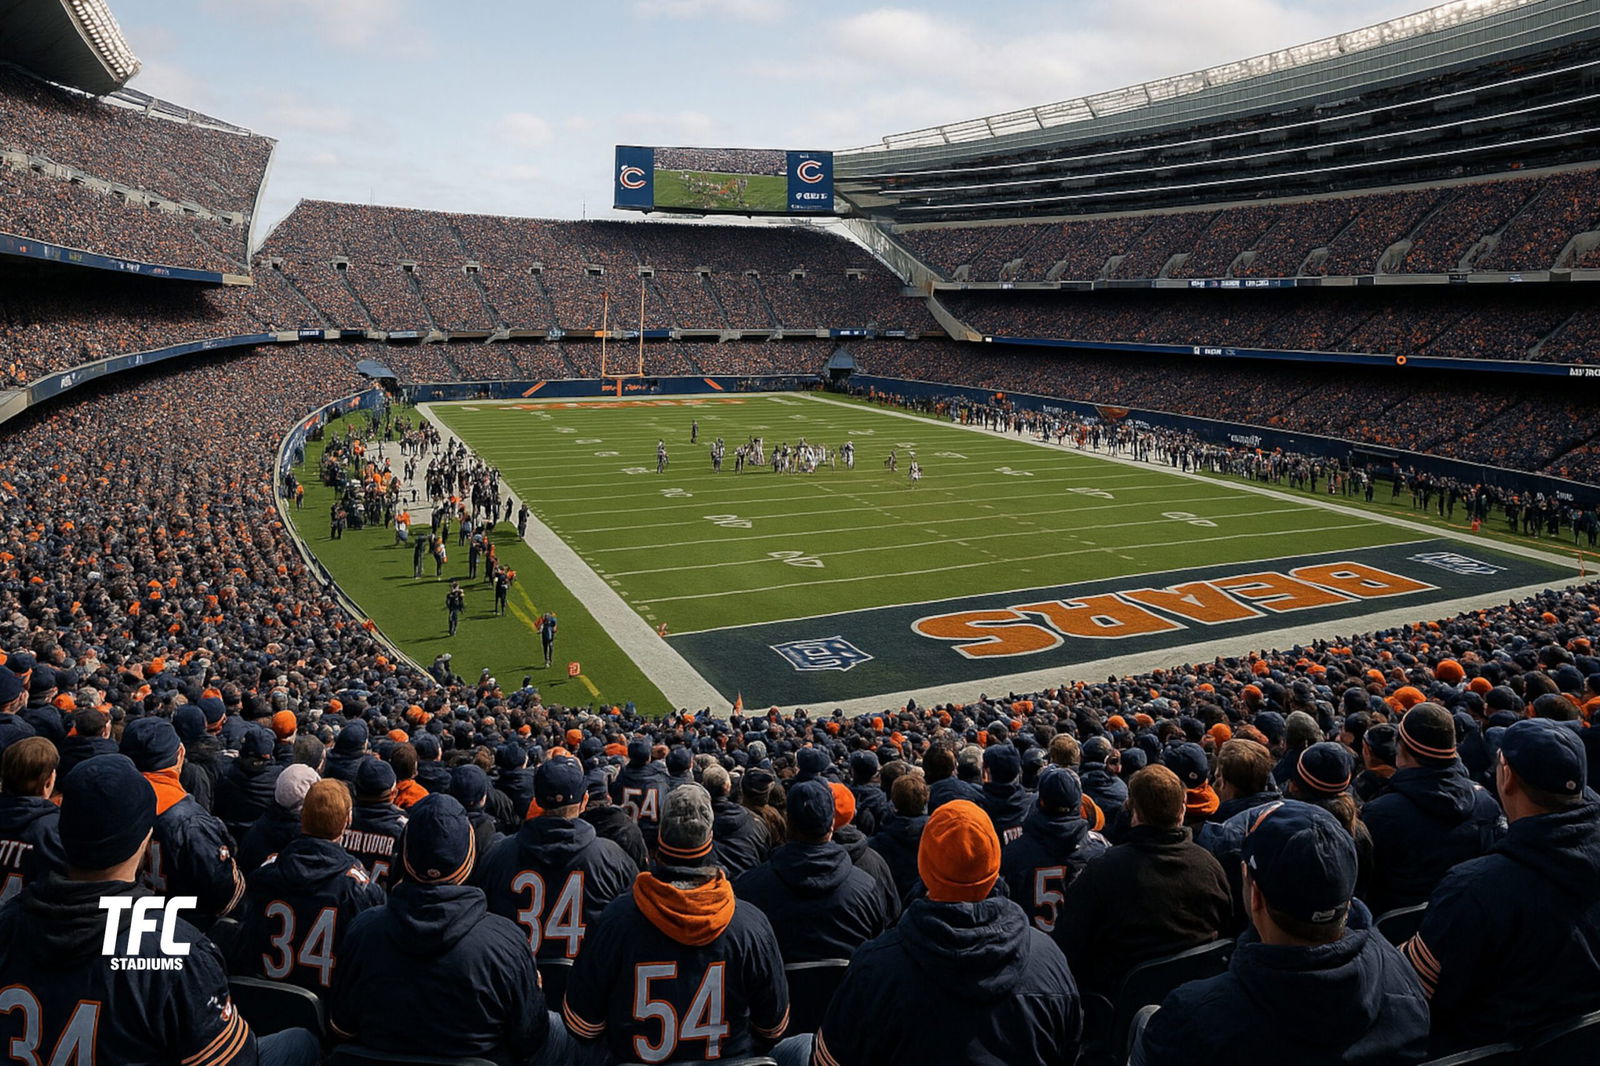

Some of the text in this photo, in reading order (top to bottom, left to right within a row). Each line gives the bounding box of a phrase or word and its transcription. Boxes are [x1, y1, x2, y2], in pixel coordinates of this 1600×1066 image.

[911, 561, 1440, 659] BEARS
[623, 786, 659, 824] 54
[262, 900, 338, 987] 34
[510, 870, 586, 958] 34
[633, 961, 729, 1064] 54
